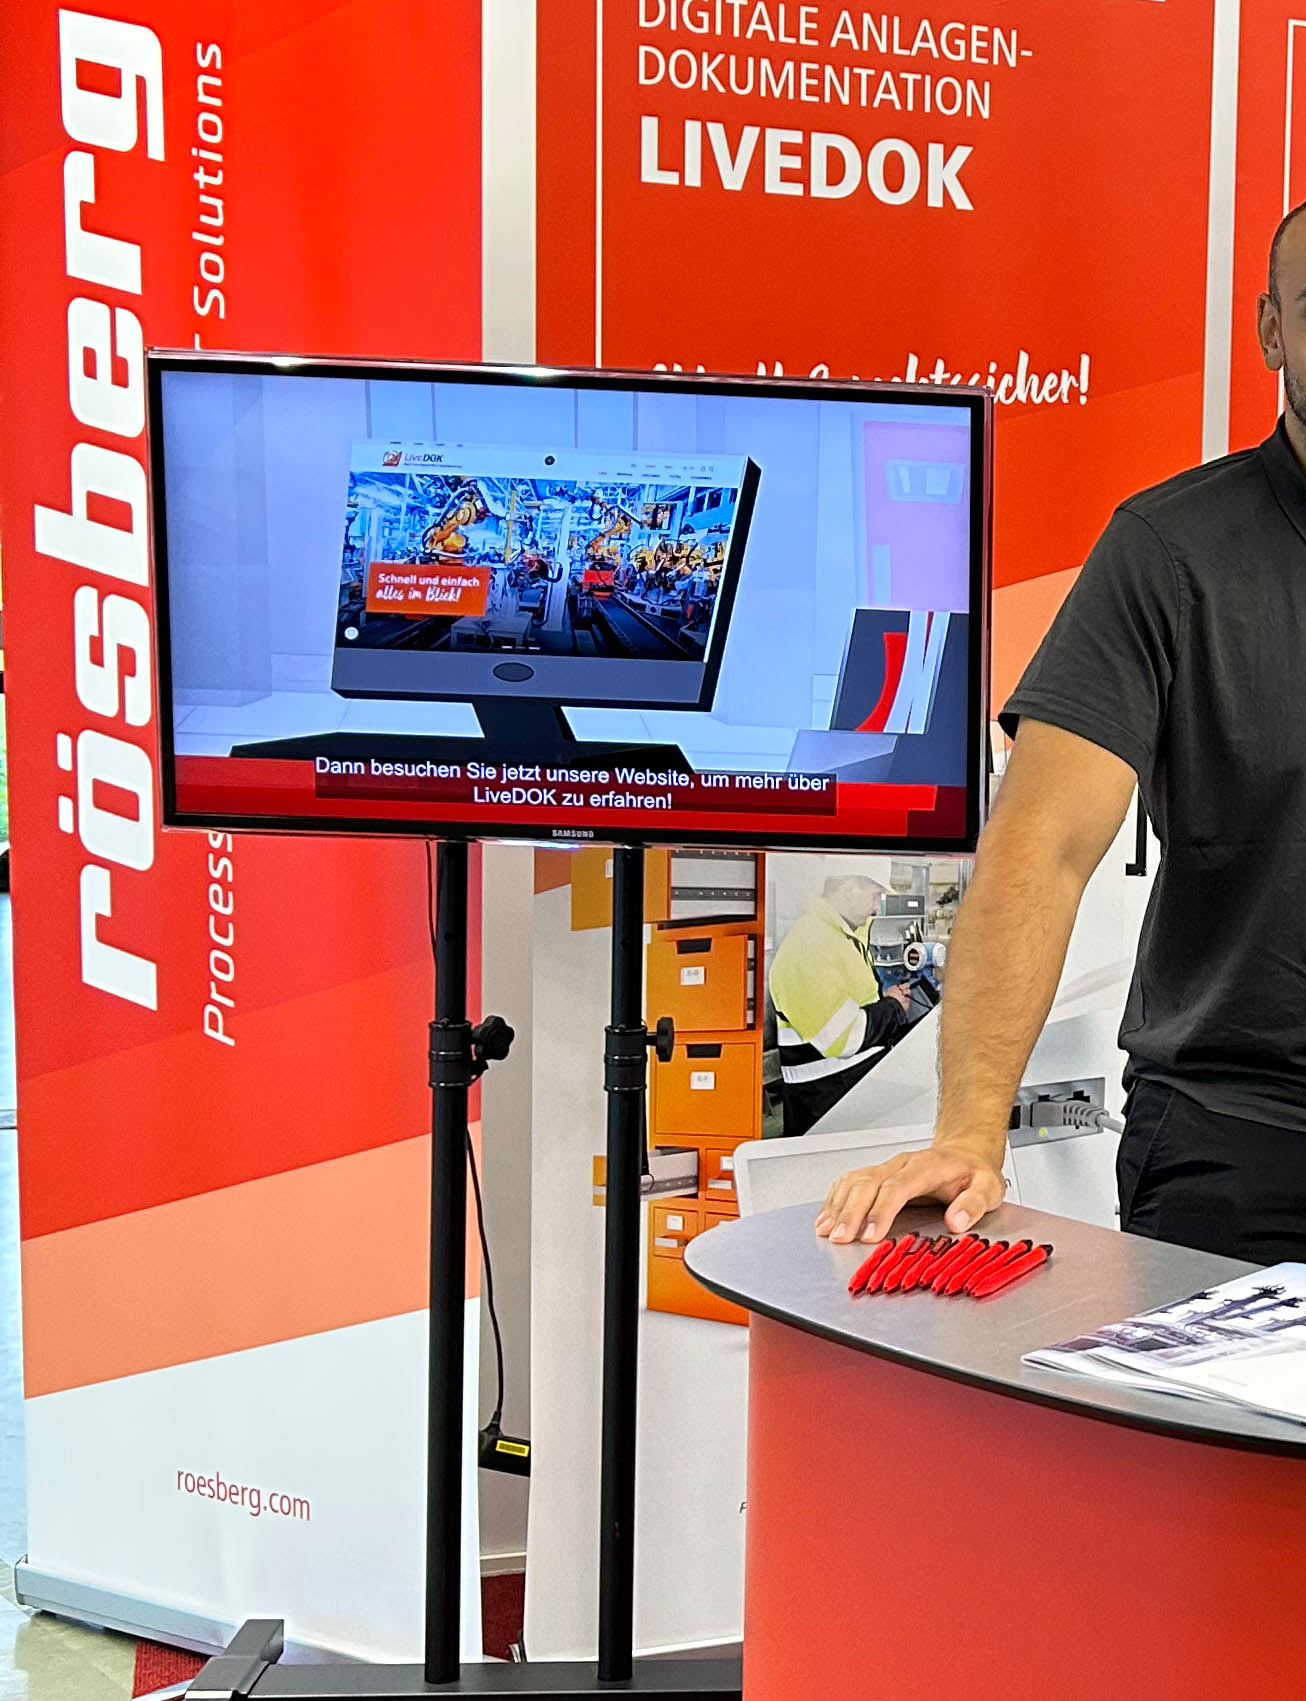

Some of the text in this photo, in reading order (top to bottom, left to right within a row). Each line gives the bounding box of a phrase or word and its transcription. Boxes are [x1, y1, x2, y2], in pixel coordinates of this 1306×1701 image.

[638, 0, 1032, 67] DIGITALE ANLAGEN-
[638, 45, 991, 119] DOKUMENTATION
[191, 42, 225, 319] Solutions
[641, 115, 974, 210] LIVEDOK
[34, 8, 164, 1010] rösberg
[376, 585, 404, 600] alles
[378, 573, 480, 587] Schnell und einfach
[315, 757, 830, 791] Dann besuchen Sie jetzt unsere Website, um mehr über
[473, 786, 672, 809] LiveDOK zu erfahren!
[176, 1470, 311, 1521] roesberg.com
